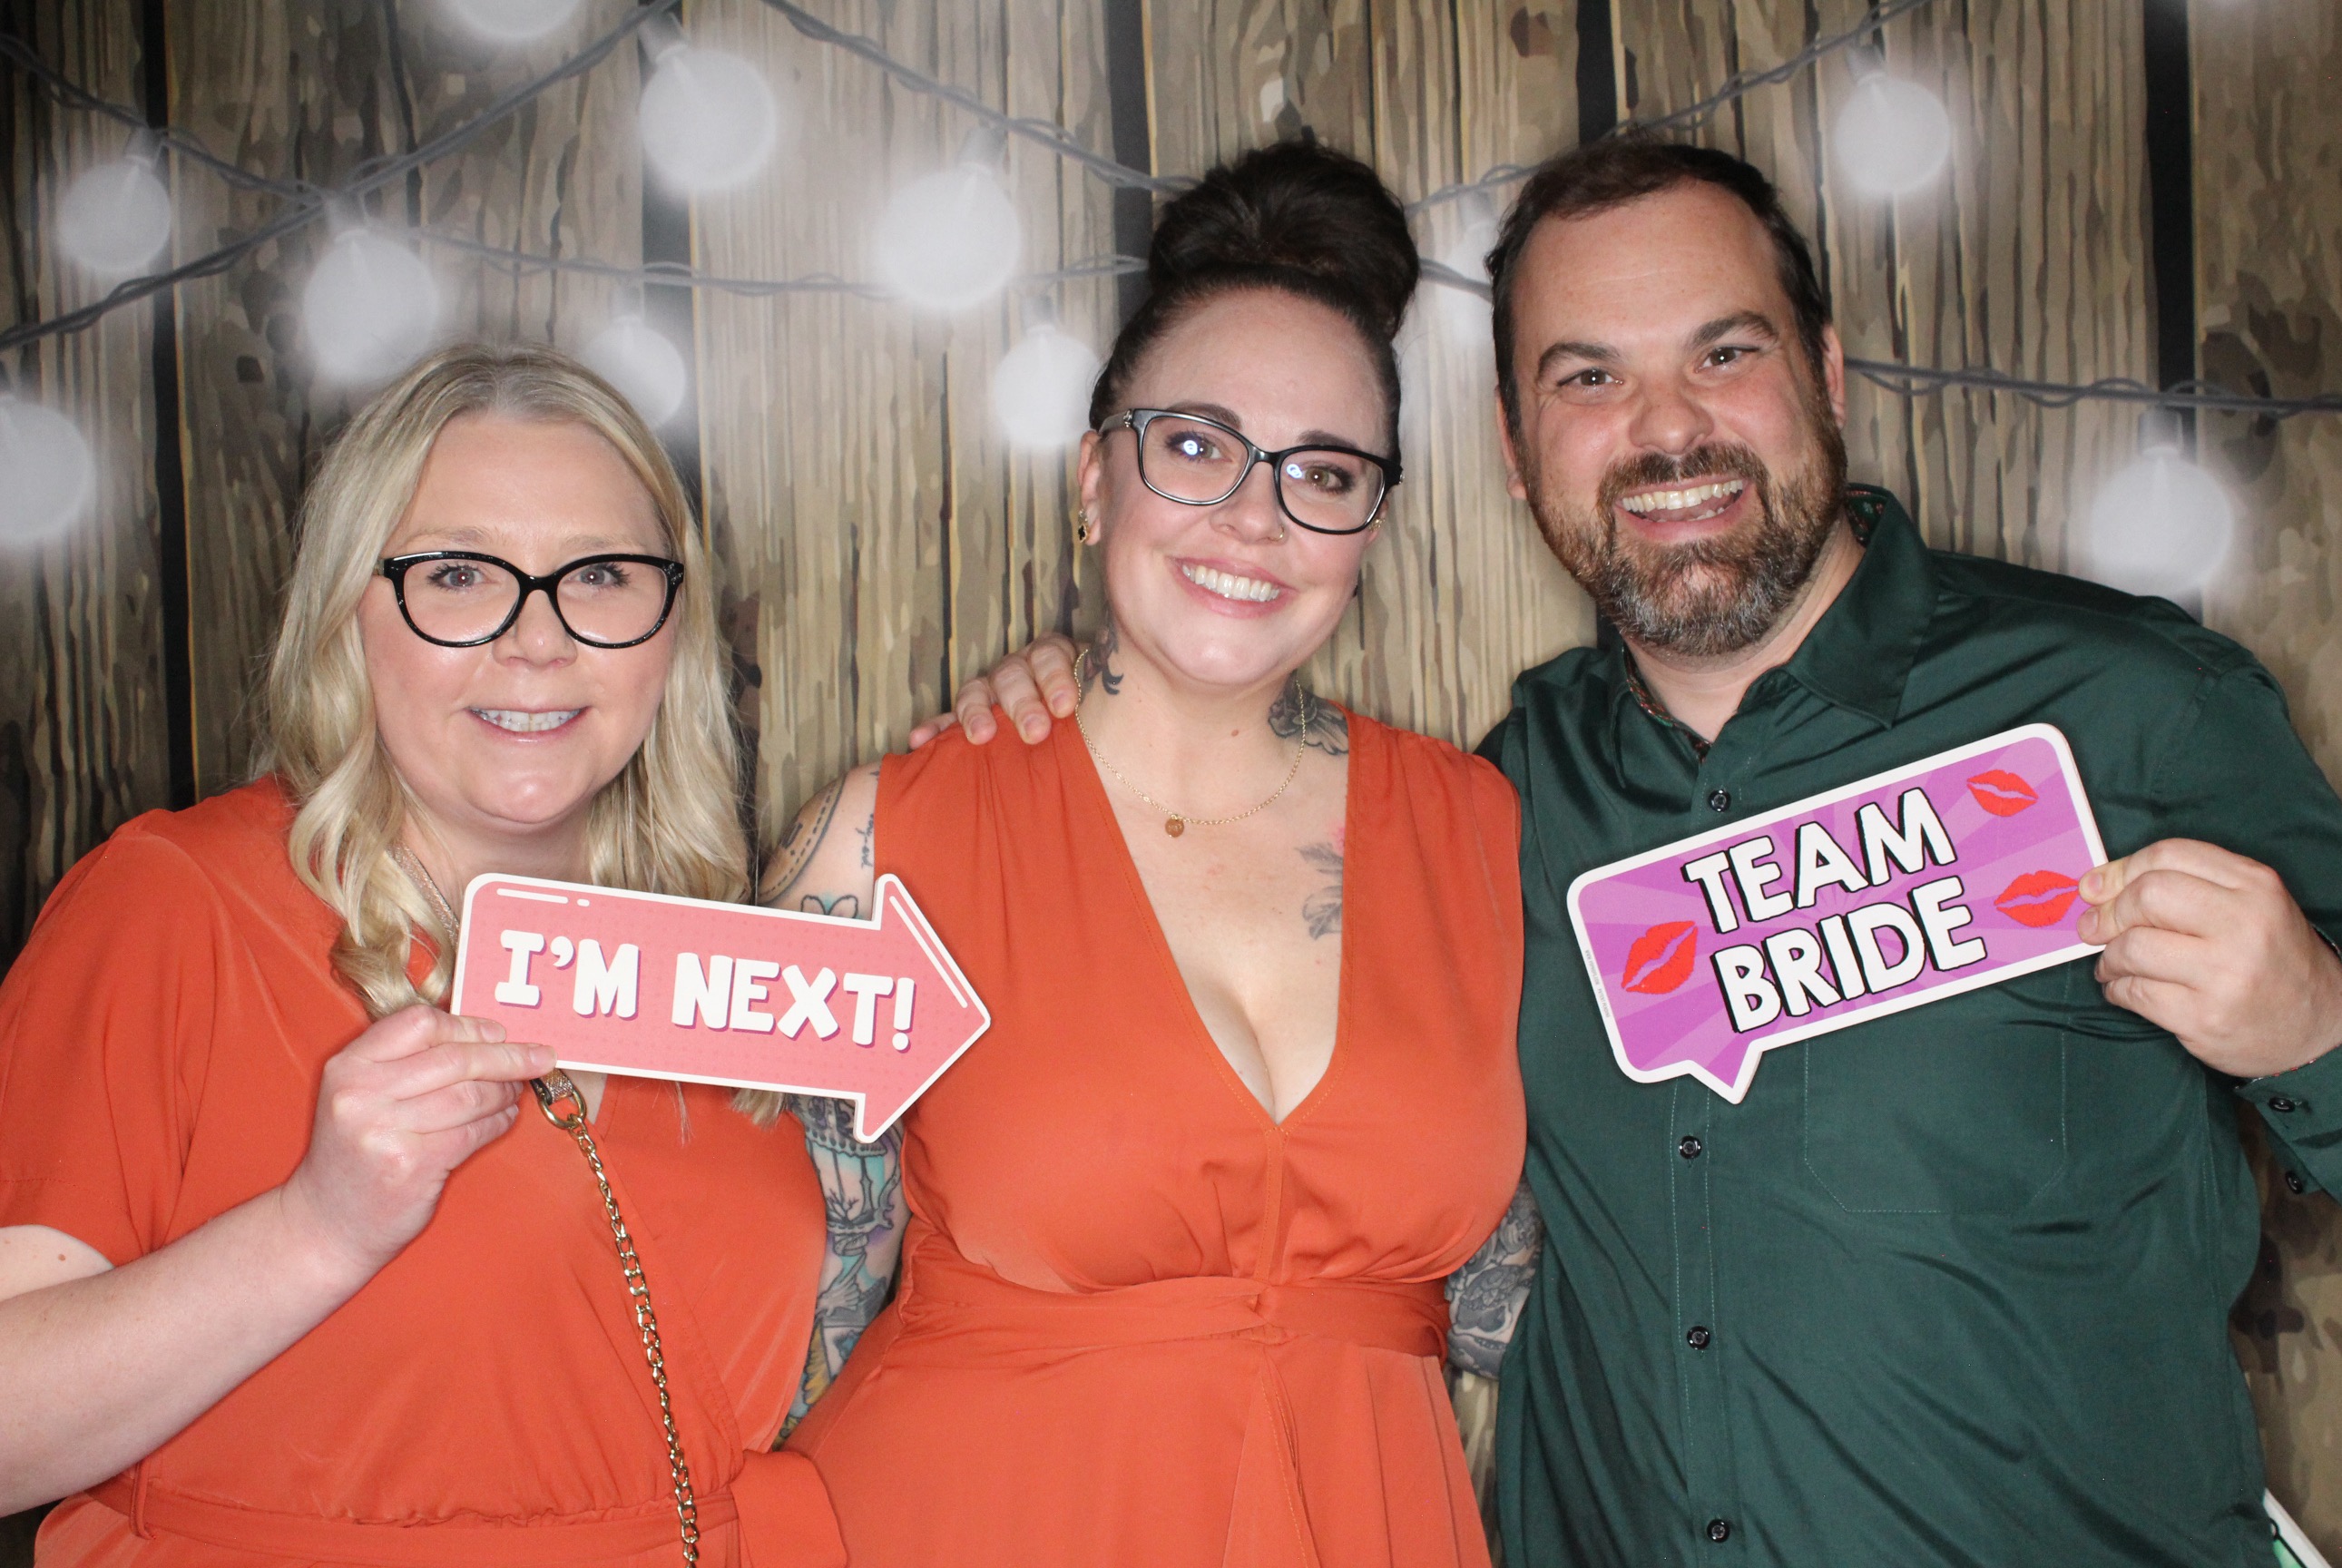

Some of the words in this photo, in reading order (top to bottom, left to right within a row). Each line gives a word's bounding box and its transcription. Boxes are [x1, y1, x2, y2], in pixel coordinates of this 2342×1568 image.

[1681, 787, 1957, 934] TEAM
[495, 929, 640, 1019] I’M
[671, 952, 916, 1052] NEXT!
[1710, 876, 1986, 1033] BRIDE
